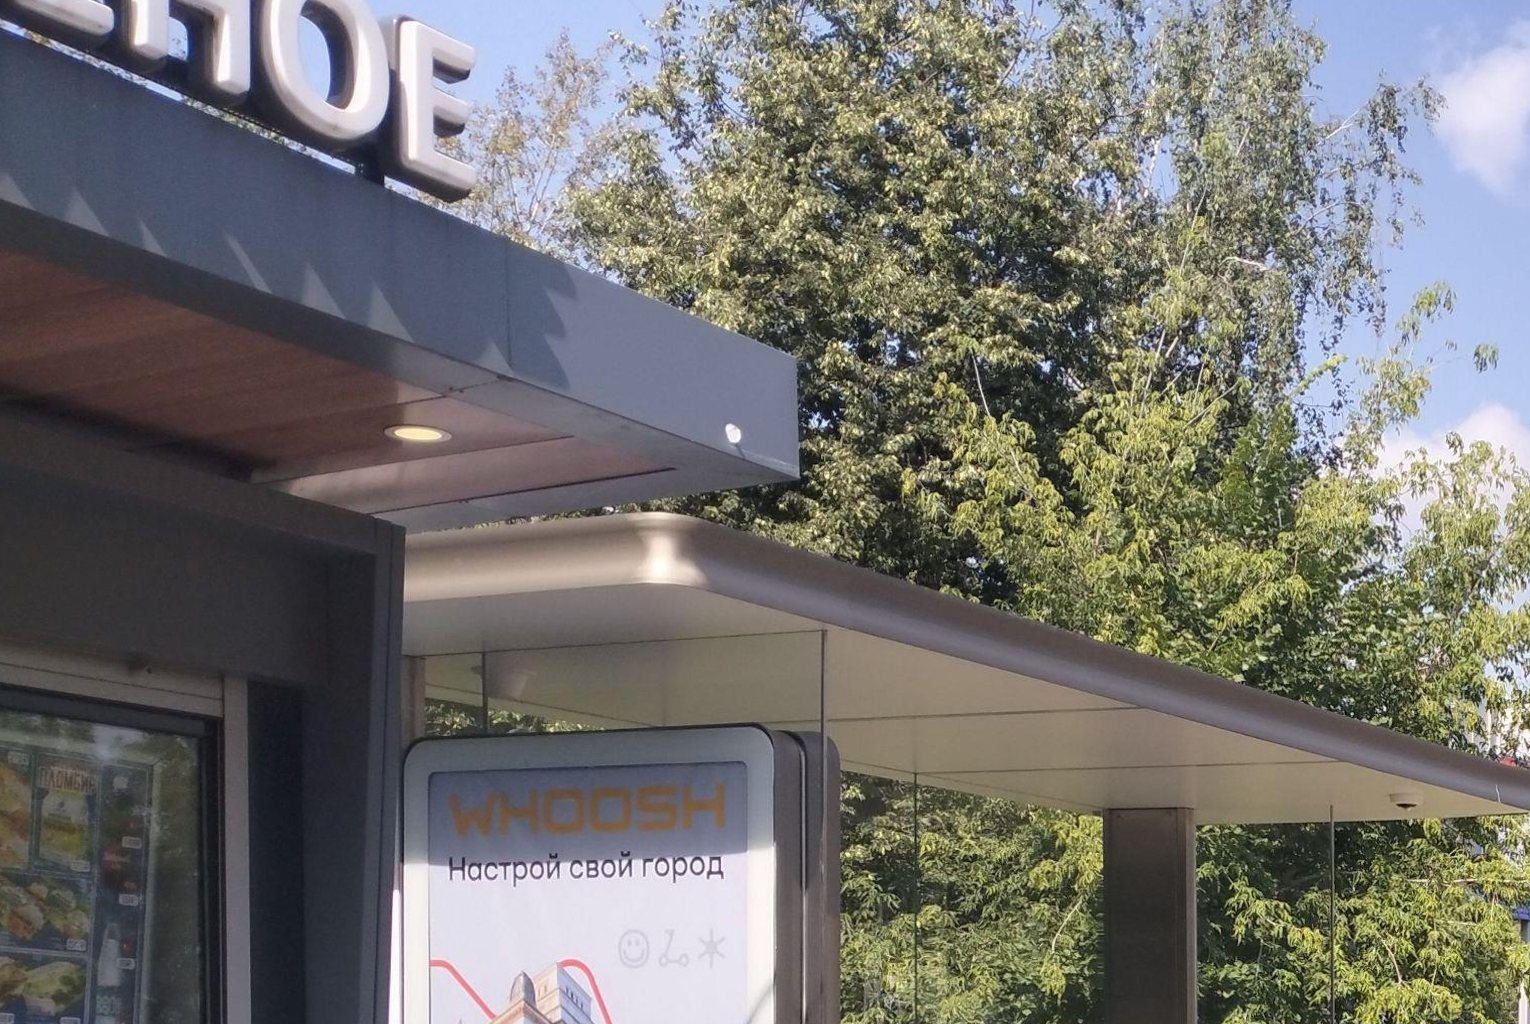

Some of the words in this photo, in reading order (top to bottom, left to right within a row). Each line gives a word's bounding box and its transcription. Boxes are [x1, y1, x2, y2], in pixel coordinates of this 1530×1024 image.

[448, 783, 727, 837] WHOOSH
[448, 852, 561, 887] Настрой
[569, 850, 633, 879] свой
[642, 855, 725, 883] город
